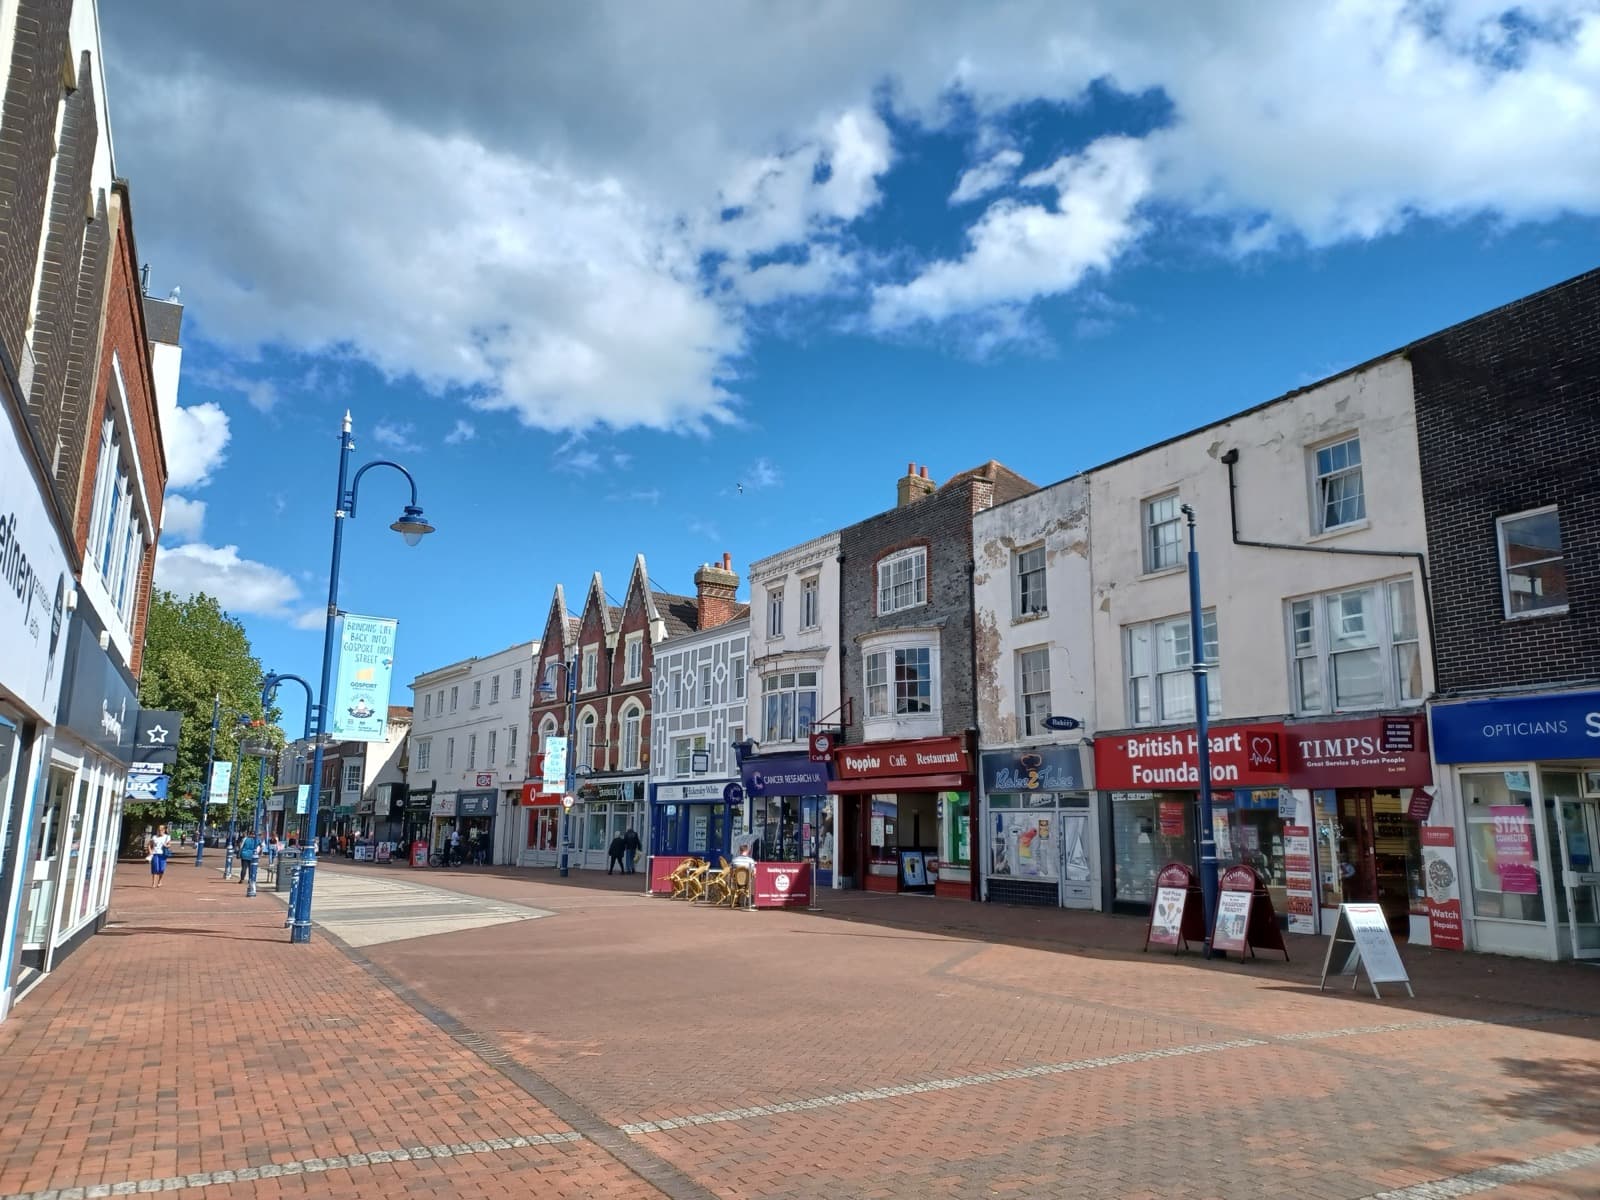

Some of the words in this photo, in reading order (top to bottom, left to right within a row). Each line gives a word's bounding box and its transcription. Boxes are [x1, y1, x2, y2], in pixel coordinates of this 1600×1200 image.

[347, 622, 377, 634] BRINGING
[350, 633, 369, 643] BACK
[372, 634, 387, 644] INTO
[343, 642, 373, 653] GOSPORT
[354, 654, 378, 664] STREET
[350, 681, 377, 689] GOSPORT
[1051, 718, 1073, 728] Bakery
[1482, 720, 1568, 738] OPTICIANS
[1127, 734, 1183, 758] British
[845, 754, 881, 772] Poppins
[916, 751, 959, 766] Restaurant
[1306, 760, 1324, 768] Great
[1350, 760, 1359, 768] By
[1381, 756, 1405, 765] People
[995, 768, 1029, 789] Bake
[1027, 770, 1039, 789] 2
[1038, 765, 1074, 788] Take
[1132, 761, 1238, 784] Foundaion
[763, 775, 784, 785] CANCER
[784, 774, 812, 784] RESEARCH
[812, 773, 821, 783] UK
[1494, 815, 1526, 833] STAY
[1495, 834, 1528, 843] CONNECTED
[1430, 908, 1459, 919] Watch
[1433, 920, 1458, 930] Repairs
